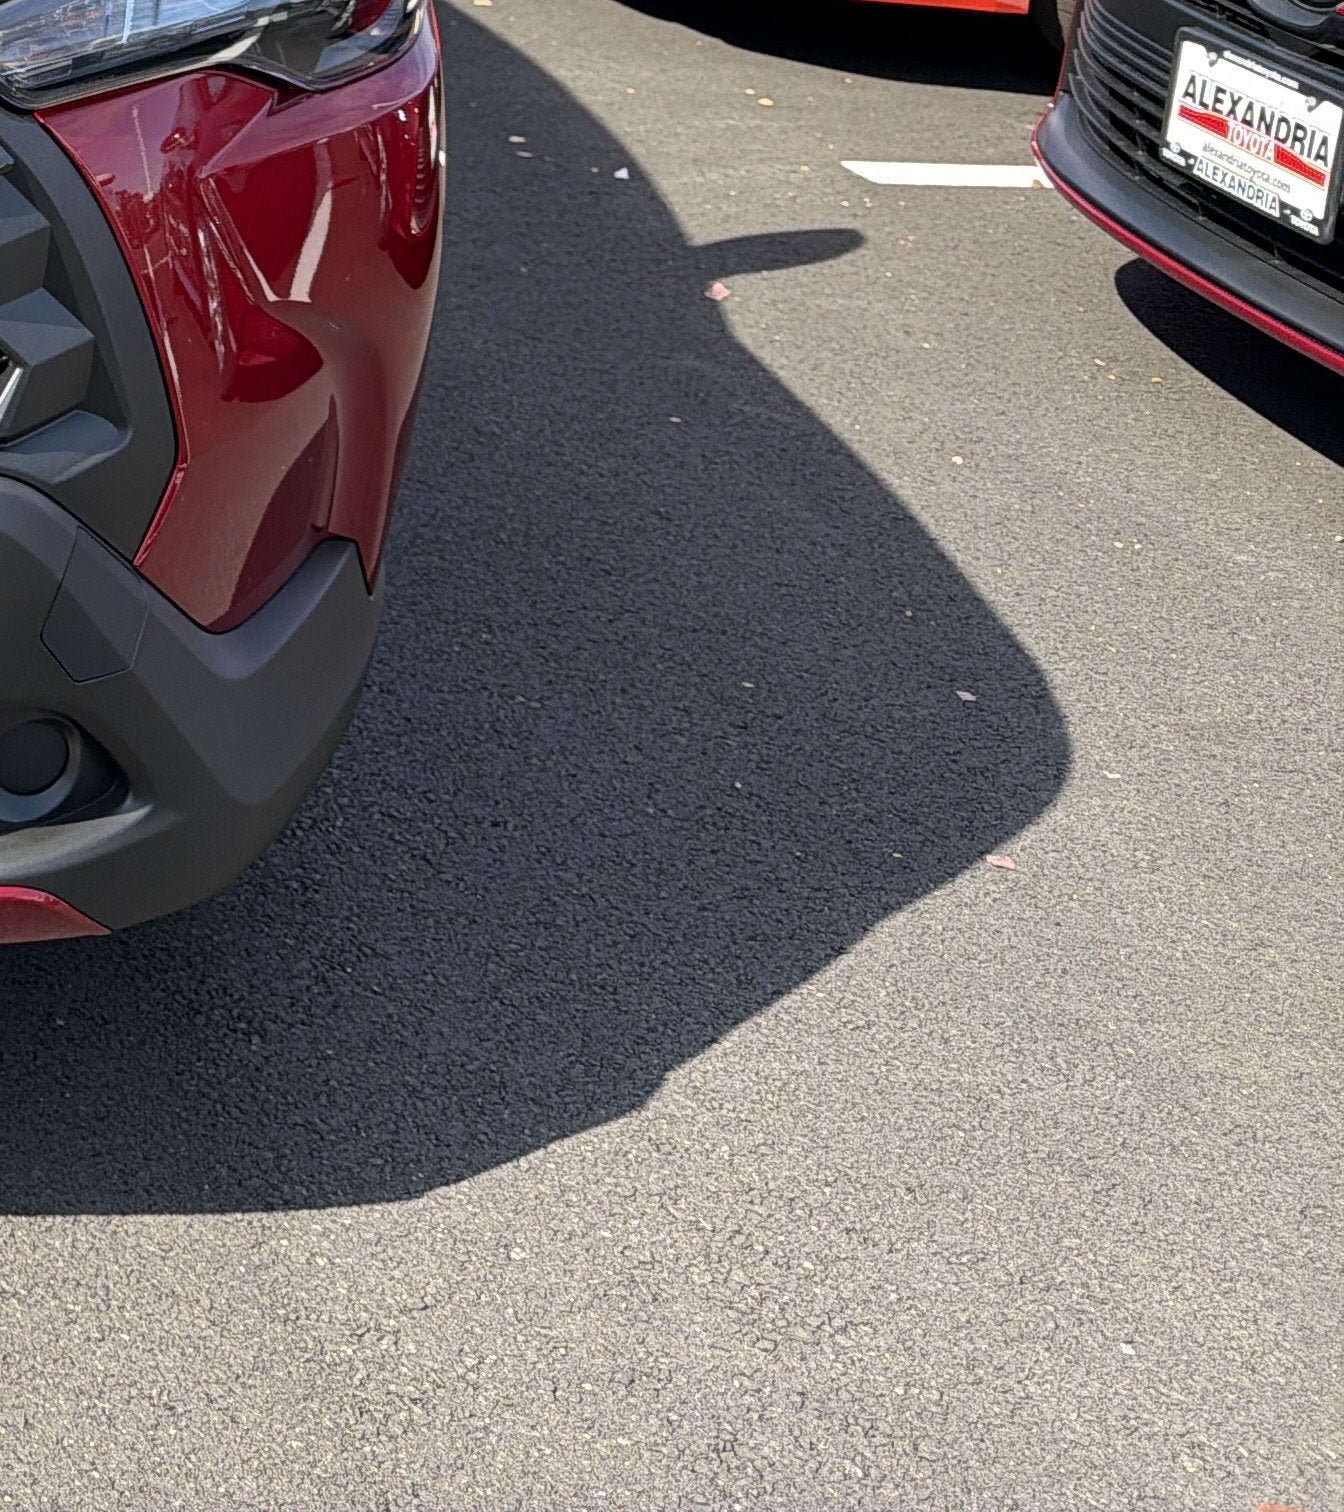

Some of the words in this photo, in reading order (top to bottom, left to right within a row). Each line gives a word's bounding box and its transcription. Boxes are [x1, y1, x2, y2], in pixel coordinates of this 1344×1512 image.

[1182, 74, 1329, 168] ALEXANDRIA
[1227, 120, 1275, 161] TOYOTA
[1195, 158, 1280, 216] ALEXANDRIA
